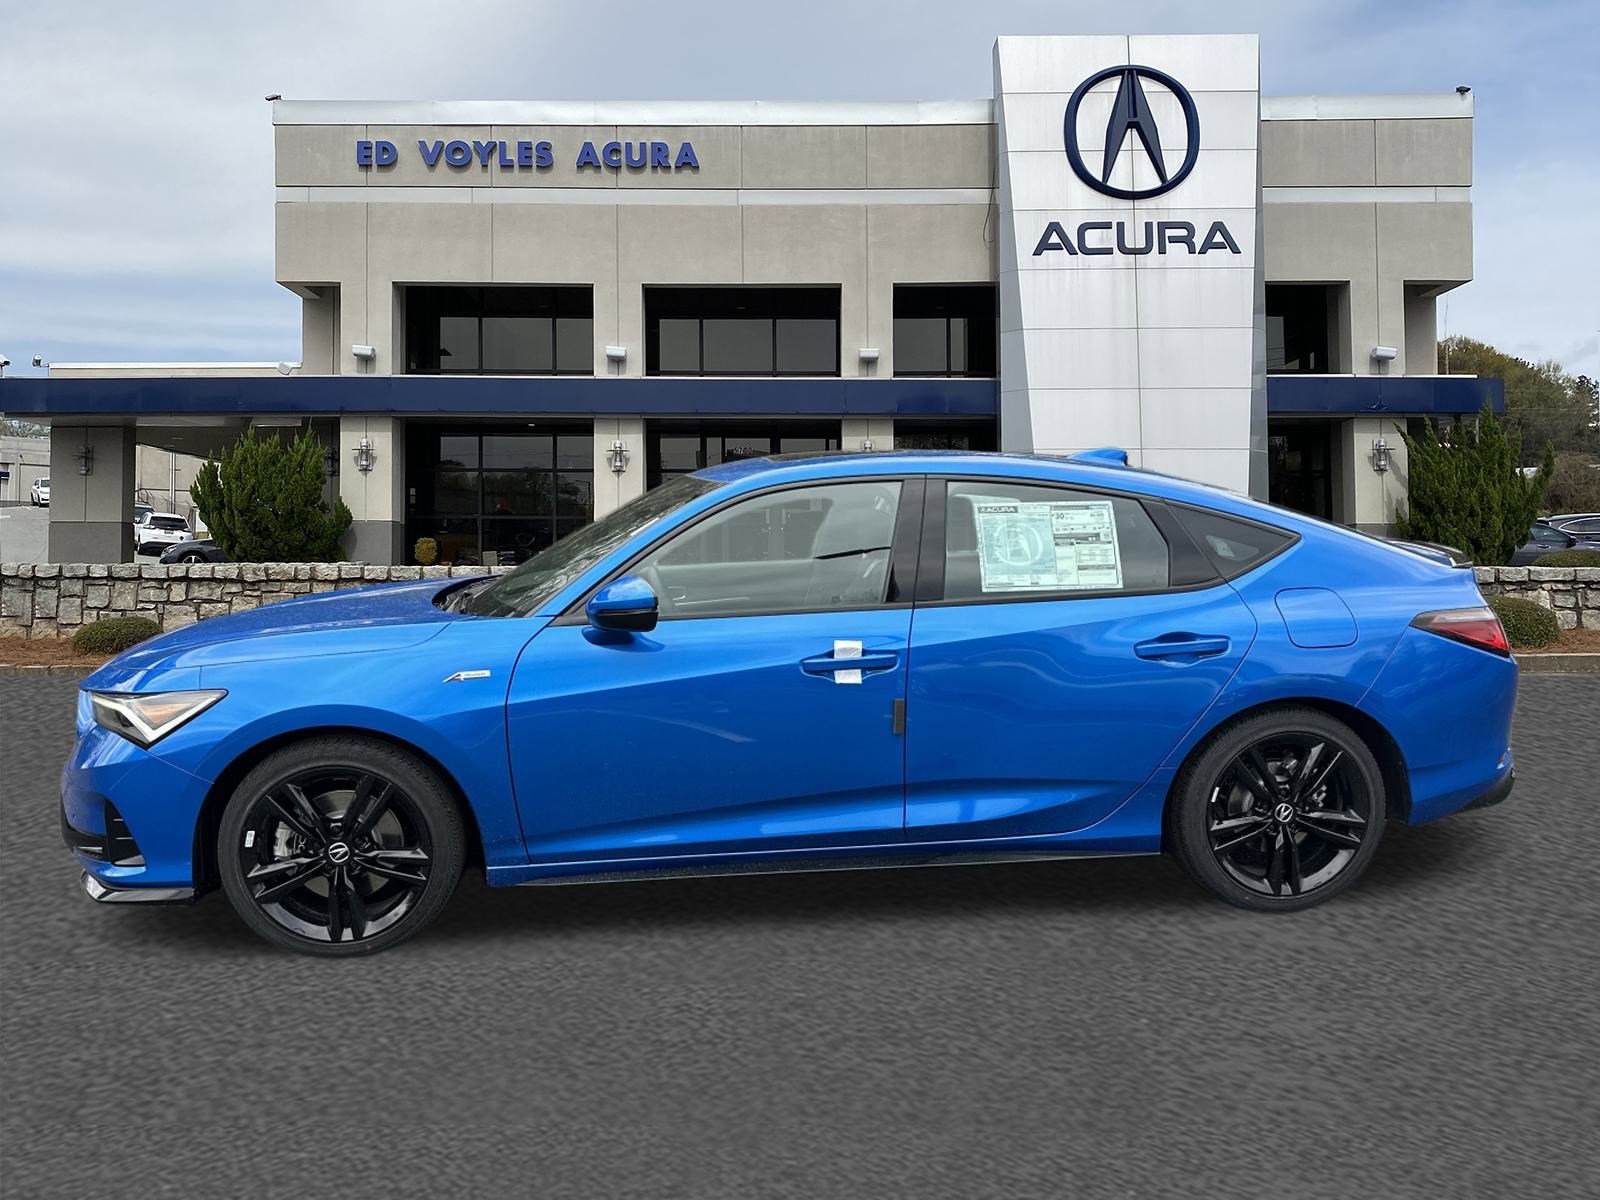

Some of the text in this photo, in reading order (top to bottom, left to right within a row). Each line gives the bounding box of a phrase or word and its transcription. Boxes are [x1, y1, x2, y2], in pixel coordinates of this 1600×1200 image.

[356, 140, 700, 169] ED VOYLES ACURA
[1032, 221, 1242, 256] ACURA
